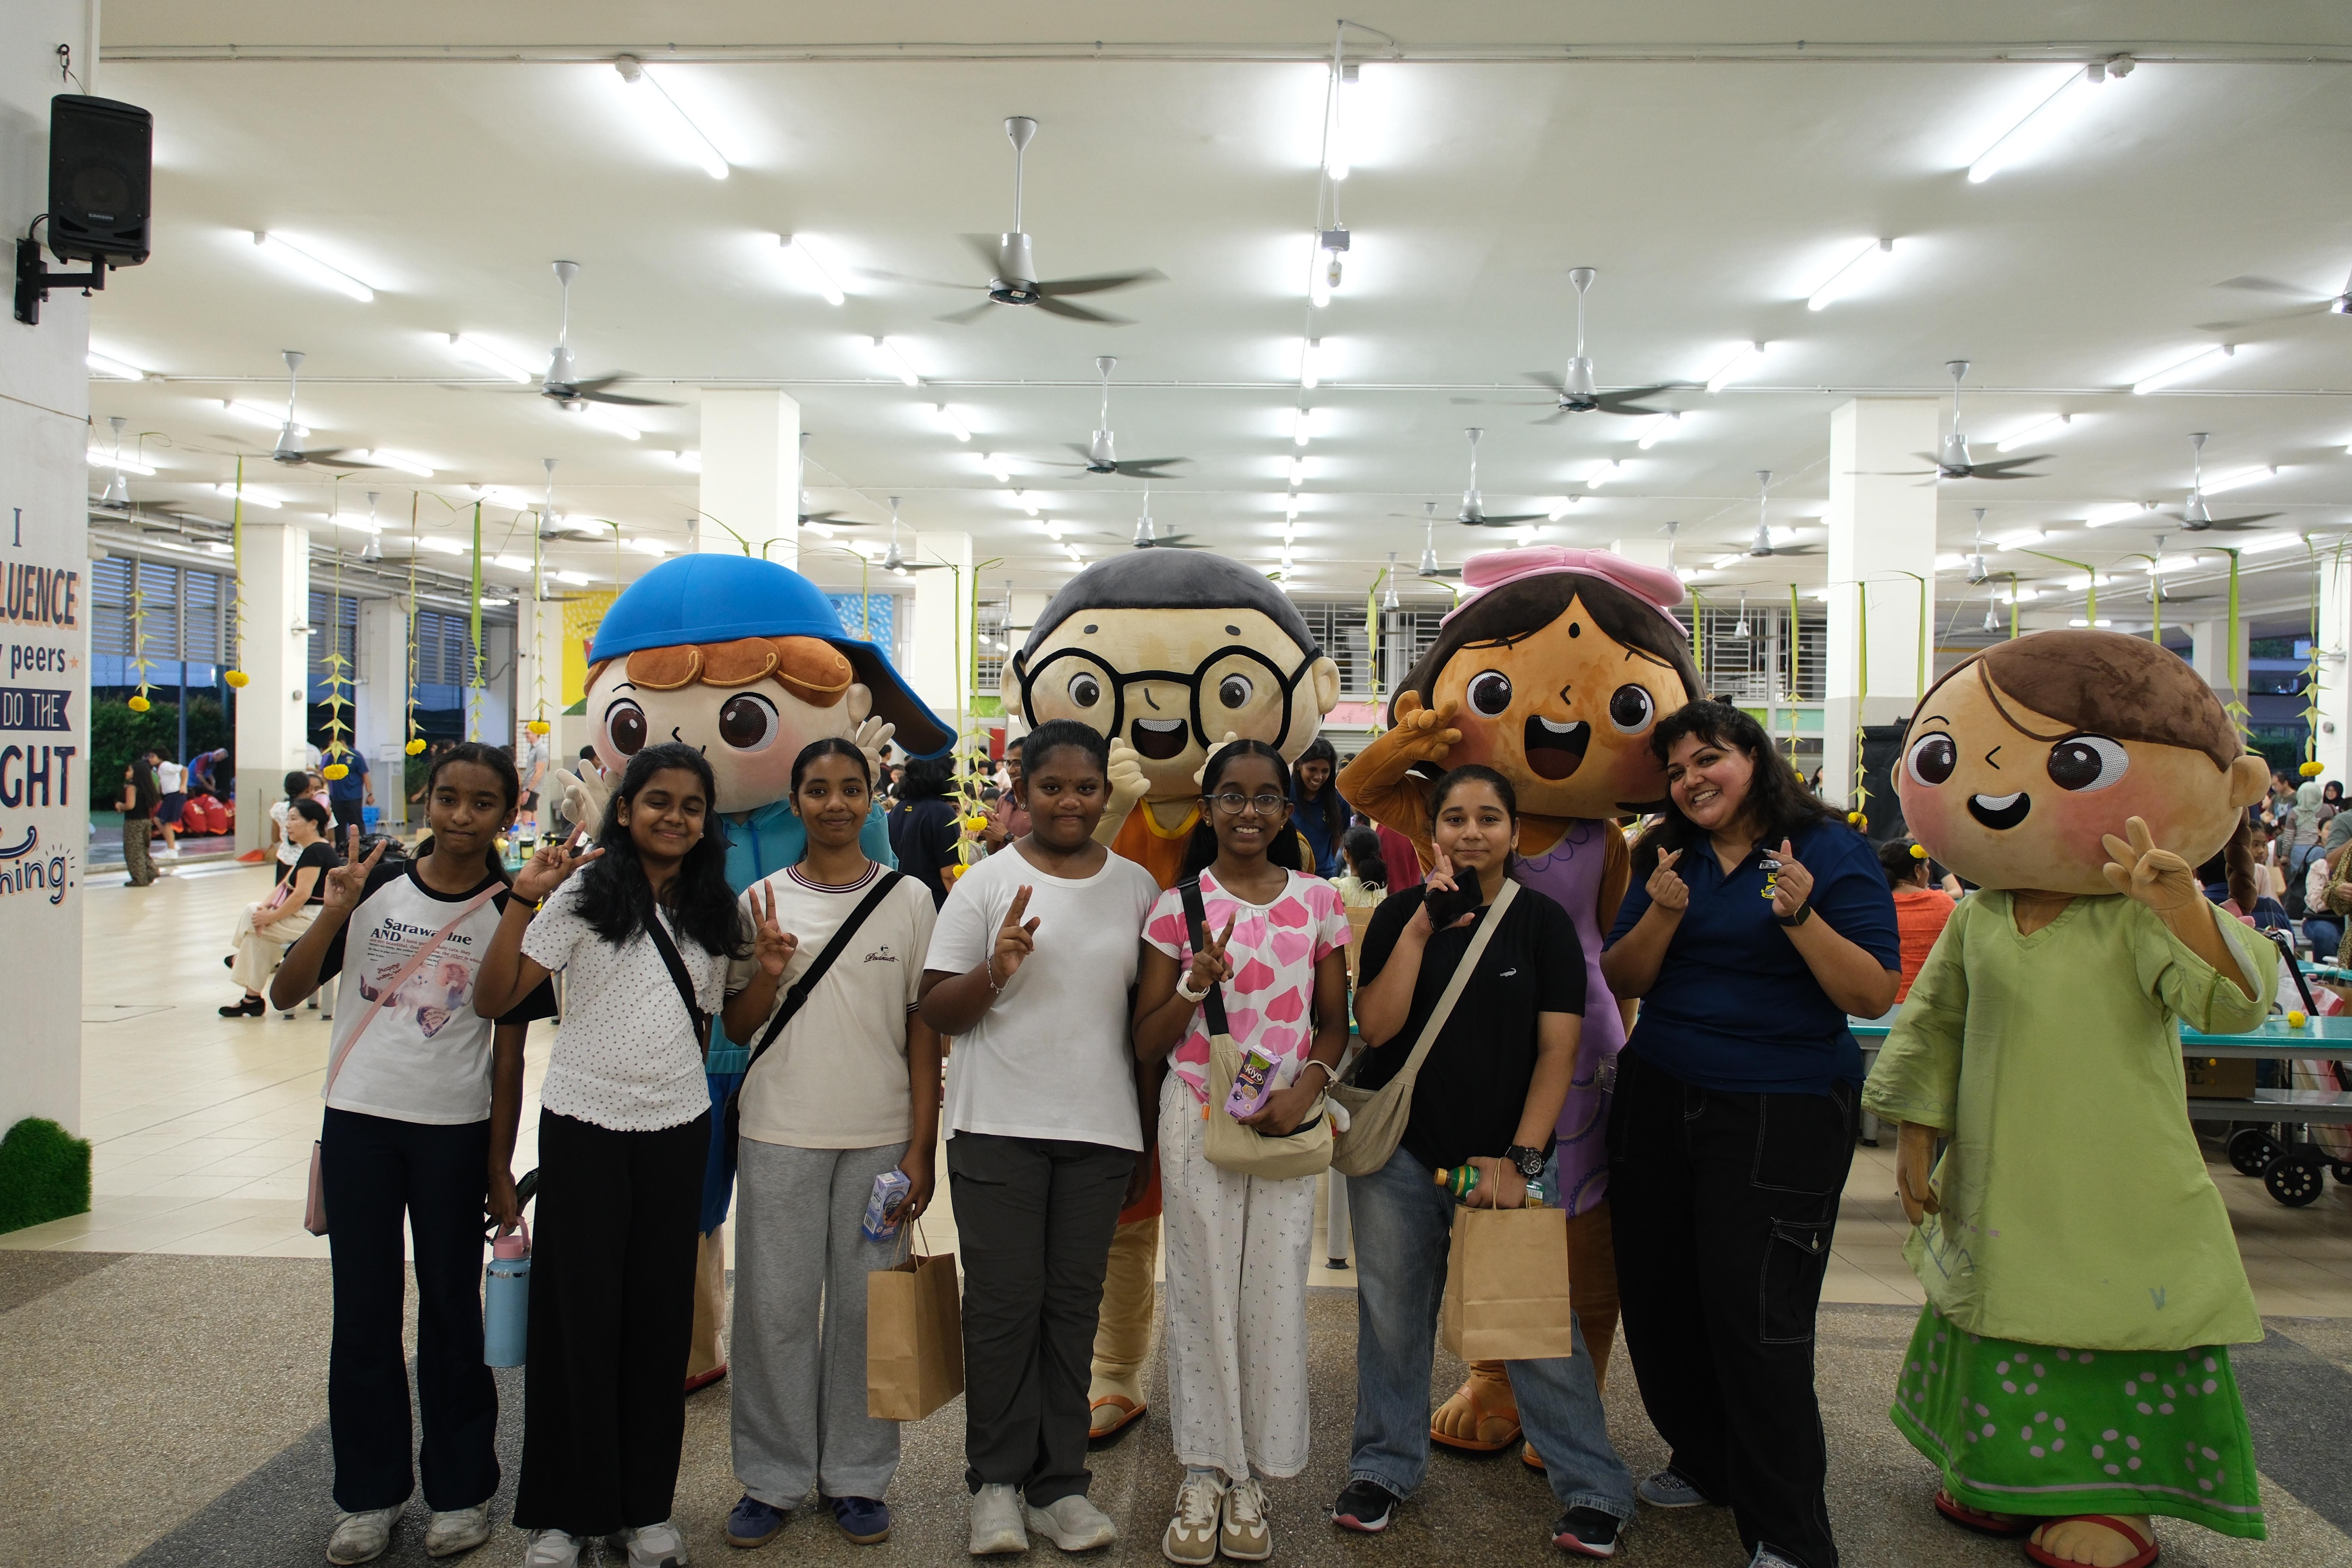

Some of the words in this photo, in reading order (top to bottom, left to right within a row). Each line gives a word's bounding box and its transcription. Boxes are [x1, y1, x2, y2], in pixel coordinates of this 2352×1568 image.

[12, 507, 23, 548] I
[11, 644, 66, 679] peers
[3, 692, 23, 726] DO
[32, 693, 61, 727] THE
[0, 745, 76, 808] GHT
[370, 928, 401, 942] AND
[864, 952, 899, 962] Peanuts
[1245, 1064, 1262, 1081] kiyo
